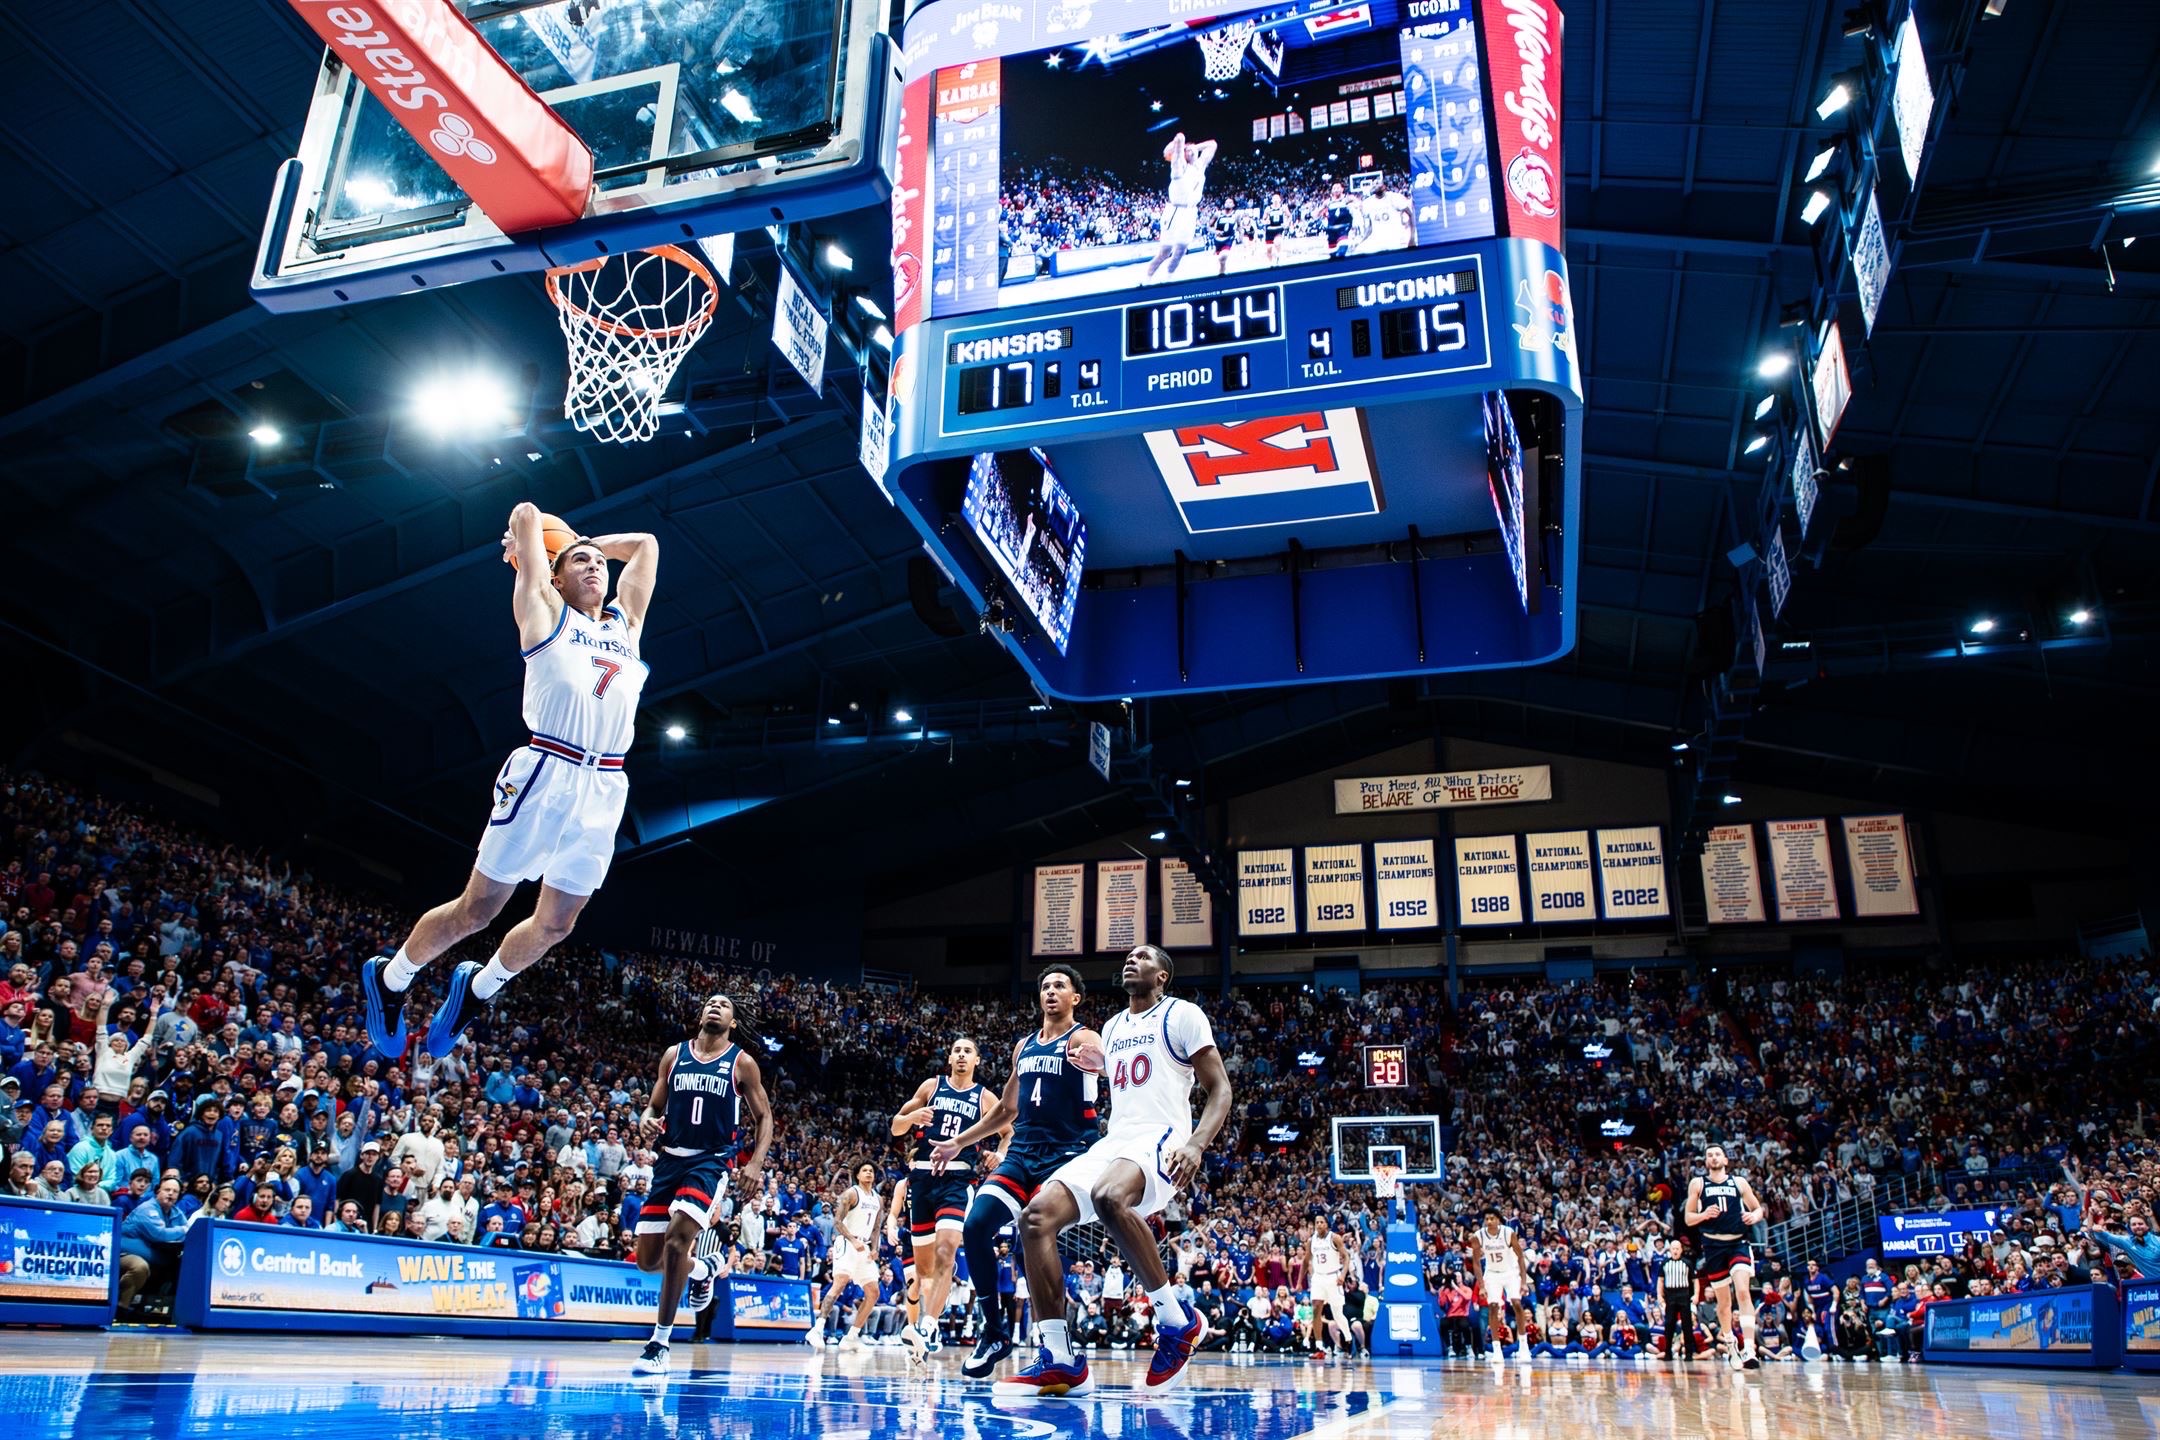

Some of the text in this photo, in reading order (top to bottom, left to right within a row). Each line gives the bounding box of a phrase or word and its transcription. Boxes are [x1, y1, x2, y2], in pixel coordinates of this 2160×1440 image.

[1409, 0, 1460, 17] UCONN
[327, 7, 448, 109] State
[1501, 0, 1556, 149] Wendy's
[940, 80, 998, 105] KANSAS
[1358, 273, 1456, 307] UCONN
[791, 289, 815, 332] NCAA
[1151, 289, 1277, 349] 10:44
[1419, 303, 1467, 352] 15
[957, 329, 1062, 363] KANSAS
[1310, 330, 1330, 356] 4
[1080, 362, 1098, 386] 4
[1148, 368, 1213, 391] PERIOD
[1240, 355, 1248, 388] 1
[1301, 360, 1343, 378] T.O.L.
[992, 362, 1032, 408] 17
[1070, 392, 1109, 408] T.O.L.
[1176, 411, 1339, 486] K
[569, 627, 633, 661] Kansas
[592, 656, 622, 700] 7
[1388, 778, 1420, 792] Heed,
[1424, 776, 1441, 789] All
[1445, 774, 1472, 787] Who
[1362, 791, 1414, 810] BEWARE
[1422, 790, 1440, 804] OF
[1776, 822, 1818, 832] OLYMPIANS
[1464, 850, 1510, 862] NATIONAL
[1535, 846, 1583, 858] NATIONAL
[1606, 842, 1655, 854] NATIONAL
[1244, 862, 1287, 874] NATIONAL
[1312, 859, 1356, 870] NATIONAL
[1382, 854, 1428, 866] NATIONAL
[1459, 863, 1516, 876] CHAMPIONS
[1531, 860, 1589, 872] CHAMPIONS
[1602, 855, 1662, 868] CHAMPIONS
[1239, 876, 1292, 888] CHAMPIONS
[1307, 872, 1362, 884] CHAMPIONS
[1378, 867, 1434, 880] CHAMPIONS
[1471, 896, 1510, 914] 1988
[1540, 891, 1585, 909] 2008
[1612, 888, 1659, 906] 2022
[1248, 907, 1285, 924] 1922
[1317, 903, 1355, 921] 1923
[1389, 900, 1427, 917] 1952
[651, 926, 776, 963] BEWARE OF
[1109, 1032, 1155, 1055] Kansas
[1017, 1056, 1063, 1077] CONNECTICUT
[1373, 1050, 1402, 1062] 10:44
[1113, 1053, 1152, 1092] 40
[1373, 1062, 1399, 1083] 28
[674, 1073, 729, 1098] CONNECTICUT
[1030, 1077, 1042, 1107] 4
[691, 1096, 704, 1125] 0
[934, 1097, 978, 1120] CONNECTICUT
[940, 1114, 962, 1138] 23
[1717, 1196, 1727, 1212] 11
[866, 1213, 872, 1226] 1
[25, 1240, 105, 1261] JAYHAWK
[1883, 1238, 1936, 1251] KANSAS 17
[22, 1257, 105, 1278] CHECKING
[252, 1248, 364, 1279] Central Bank
[1316, 1253, 1327, 1264] 13
[1489, 1252, 1504, 1263] 15
[397, 1255, 497, 1283] WAVE THE
[431, 1283, 508, 1312] WHEAT
[569, 1284, 634, 1306] JAYHAWK
[2134, 1293, 2148, 1302] Central
